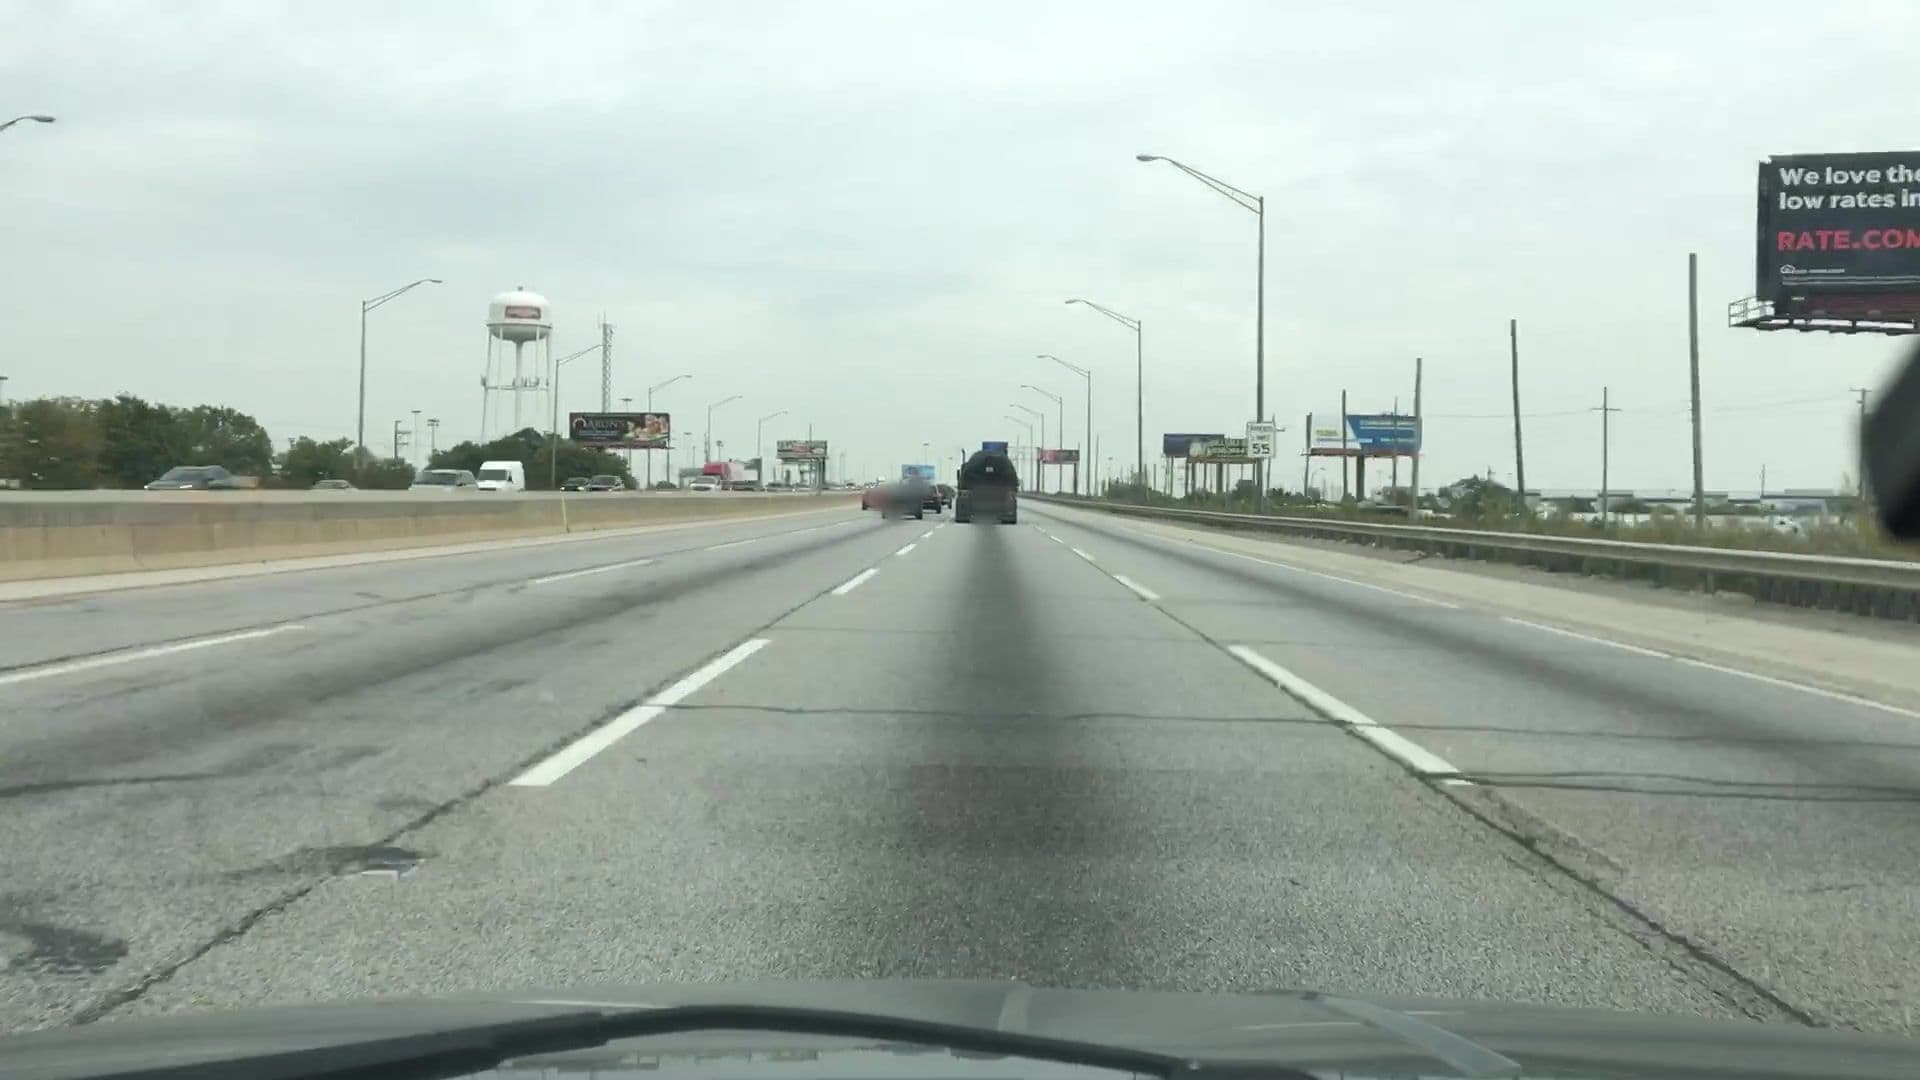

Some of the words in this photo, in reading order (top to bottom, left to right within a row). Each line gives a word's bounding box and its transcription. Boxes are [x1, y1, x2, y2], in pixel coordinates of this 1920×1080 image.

[1780, 168, 1820, 185] We
[1825, 166, 1881, 185] love
[1779, 191, 1825, 210] low
[1830, 191, 1896, 209] rates
[1252, 442, 1270, 455] 55
